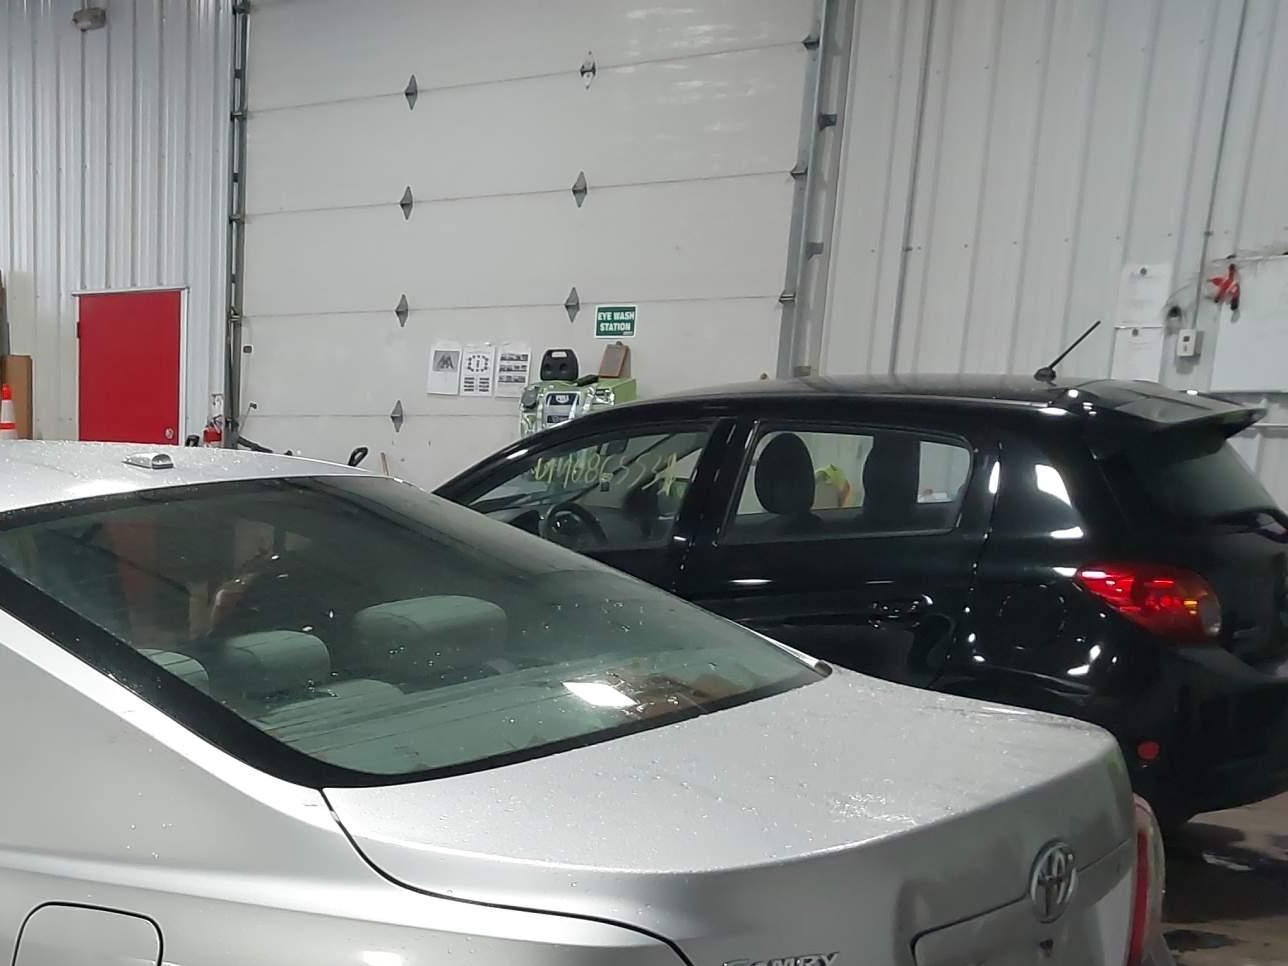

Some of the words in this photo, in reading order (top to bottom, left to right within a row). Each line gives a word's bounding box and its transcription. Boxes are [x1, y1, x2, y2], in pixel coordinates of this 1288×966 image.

[598, 311, 613, 321] EYE
[613, 311, 635, 321] WASH
[599, 322, 631, 332] STATION
